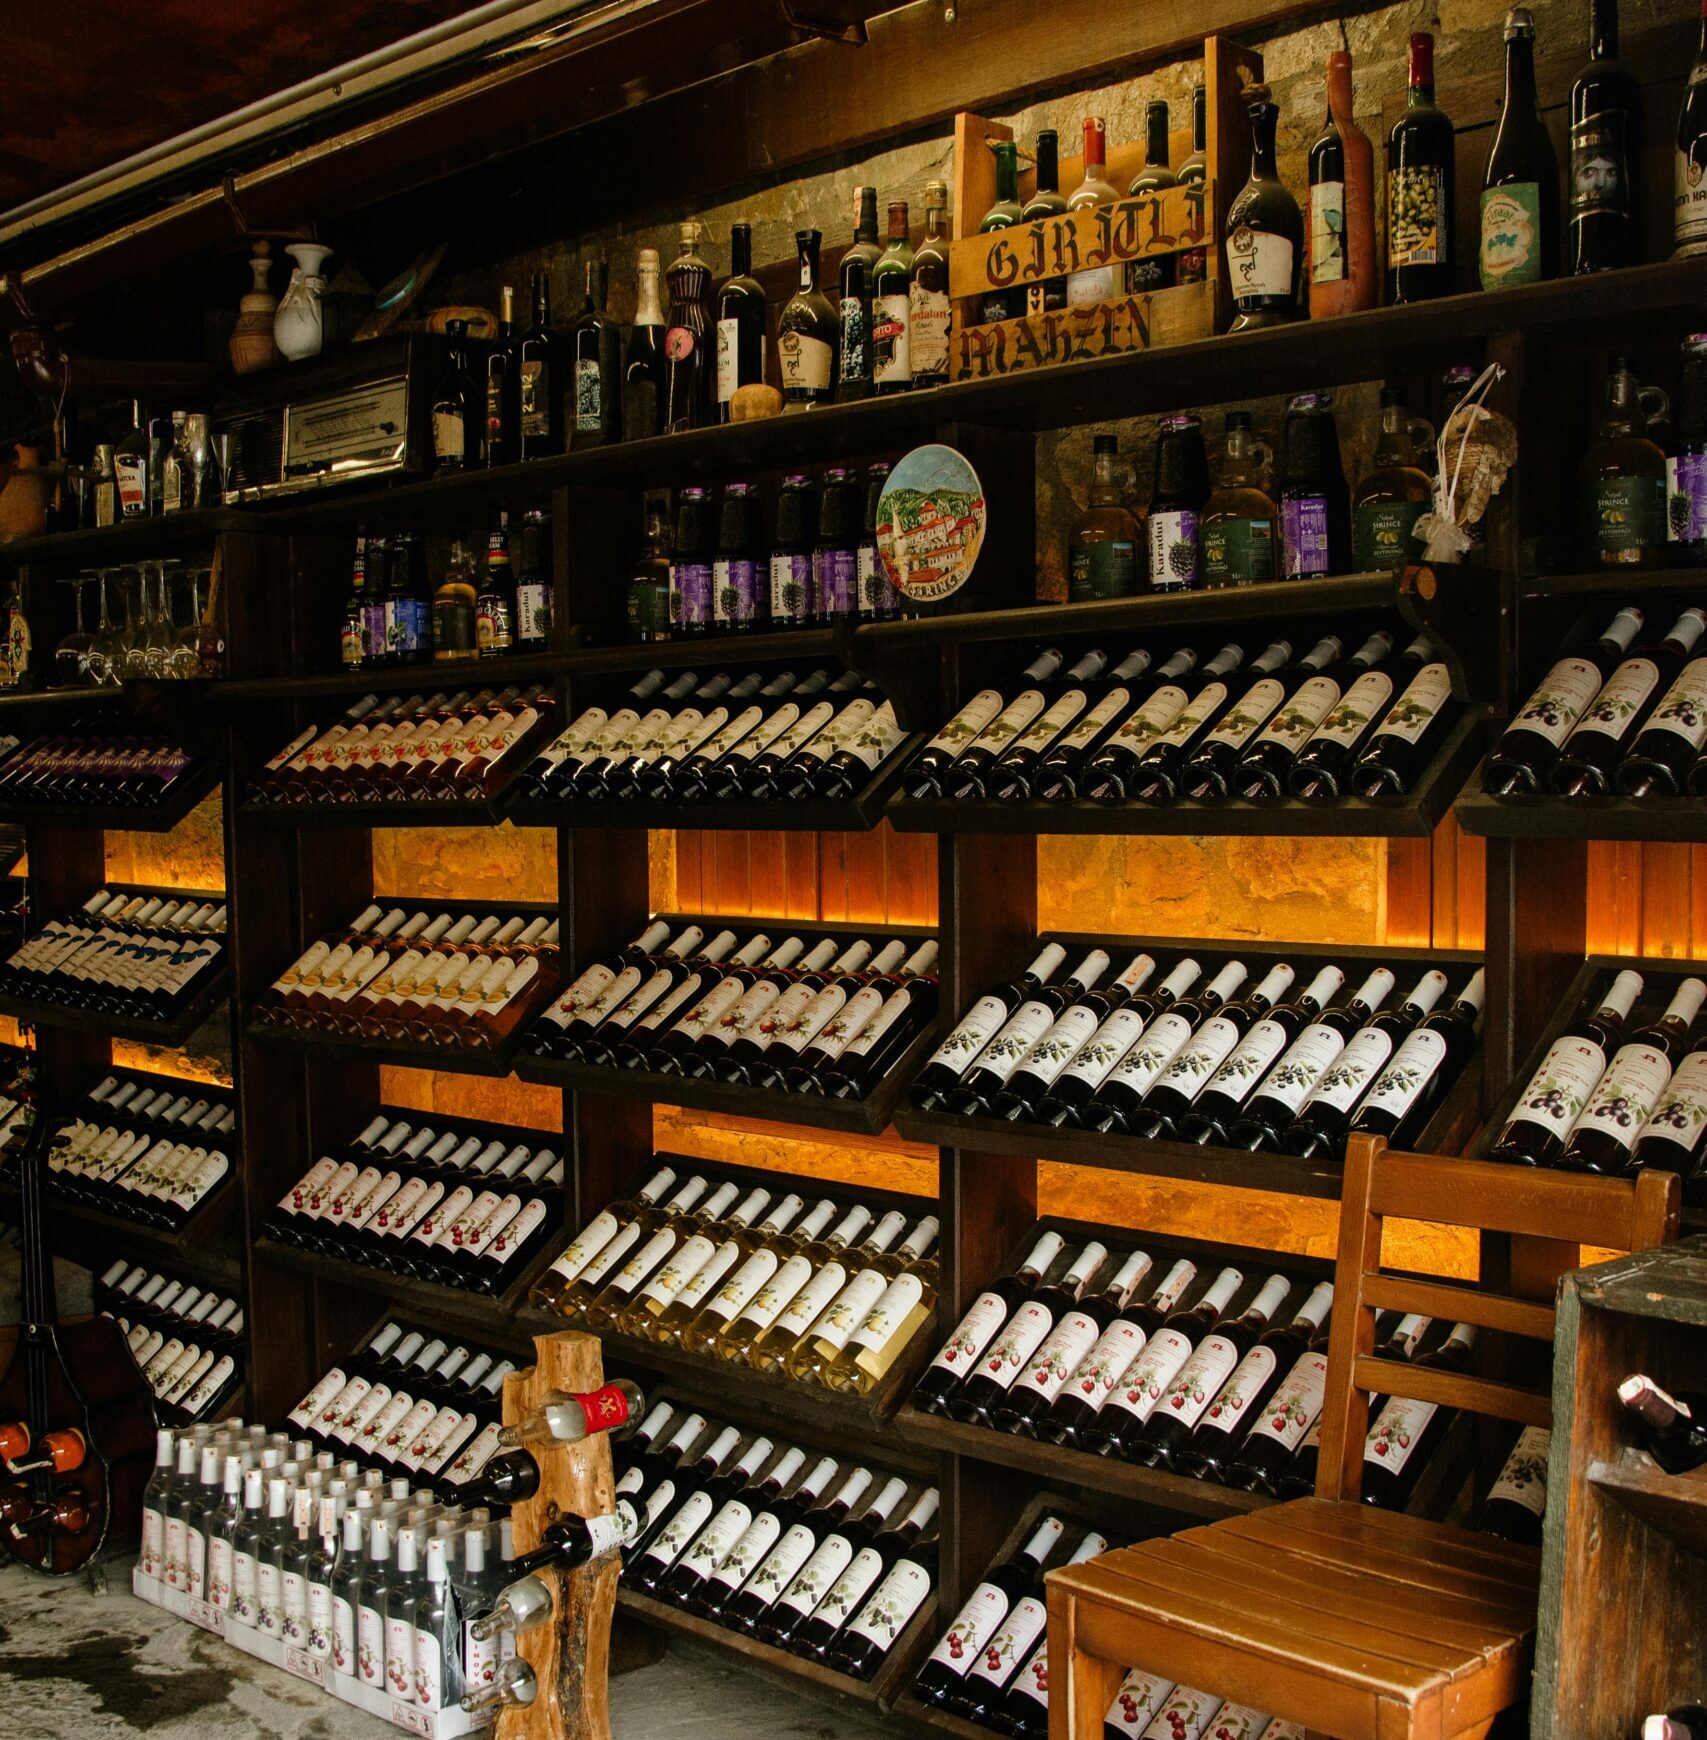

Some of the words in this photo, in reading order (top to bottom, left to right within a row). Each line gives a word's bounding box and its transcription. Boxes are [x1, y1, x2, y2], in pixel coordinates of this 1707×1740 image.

[1155, 521, 1165, 575] Karadut
[523, 591, 531, 632] Karadut
[1153, 1688, 1181, 1724] NOVA
